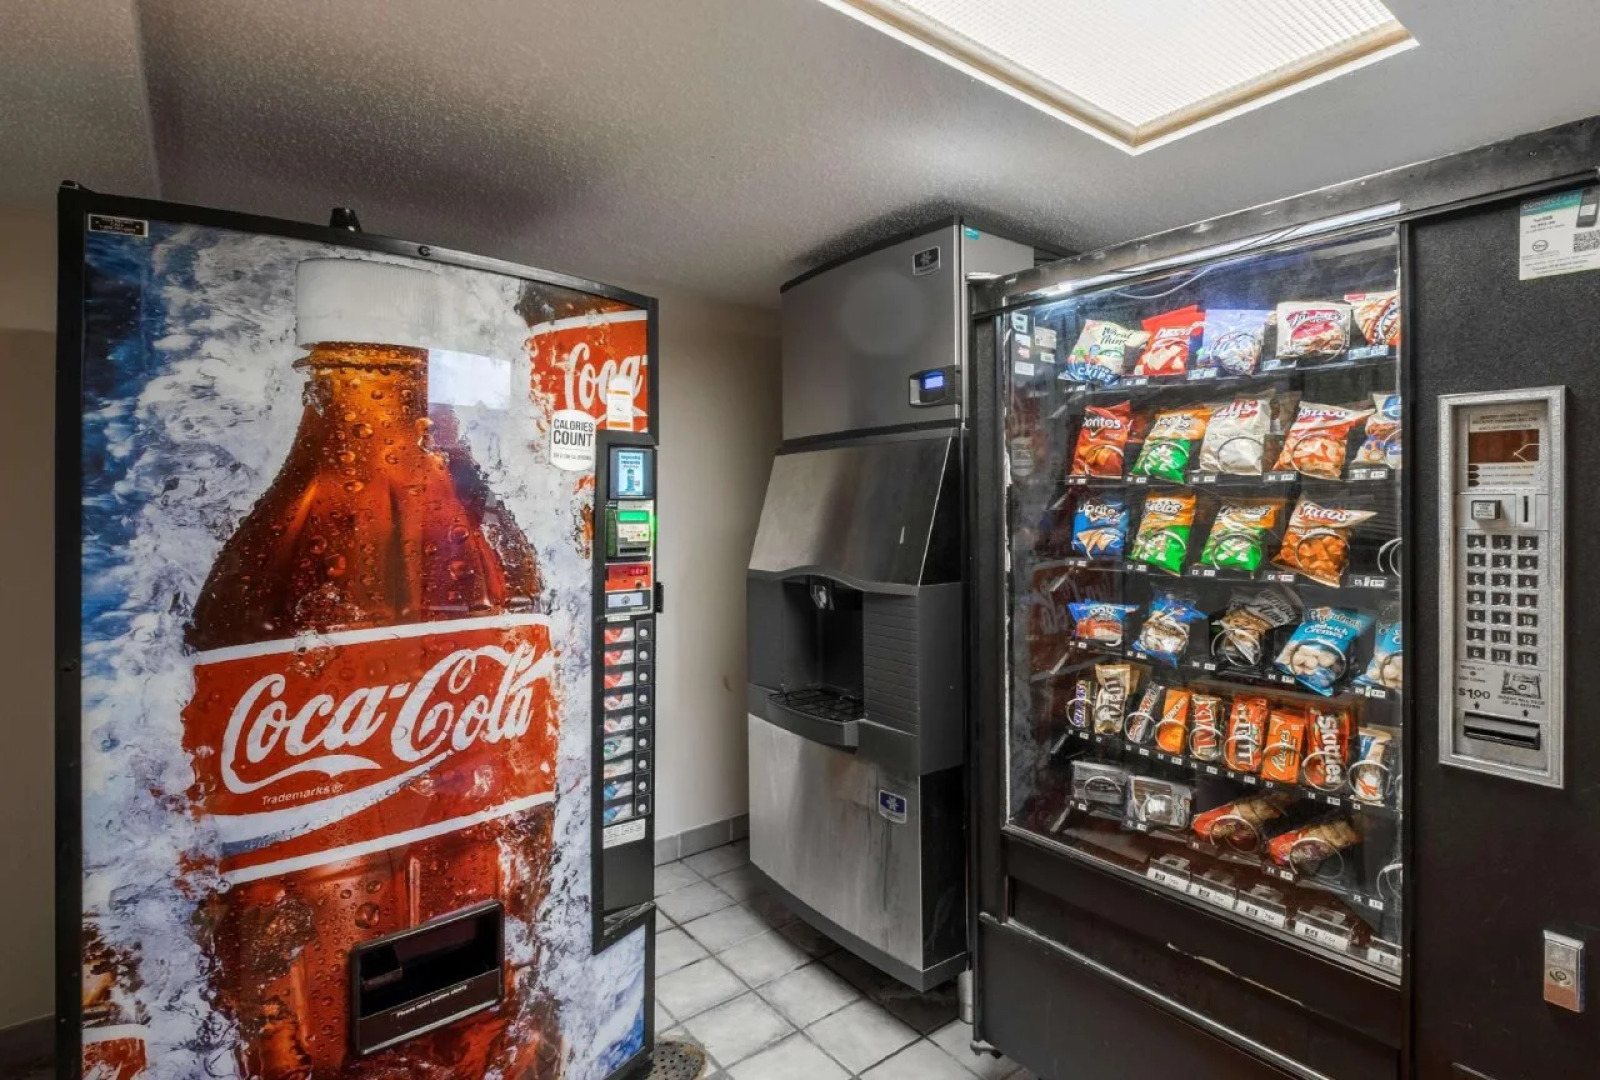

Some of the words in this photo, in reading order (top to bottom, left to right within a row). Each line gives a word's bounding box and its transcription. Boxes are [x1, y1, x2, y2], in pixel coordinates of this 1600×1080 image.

[553, 418, 594, 433] CALORIES
[553, 429, 594, 447] COUNT
[1458, 686, 1491, 701] $1.00
[221, 639, 554, 794] Coca-Cola
[1316, 714, 1342, 785] Skittles
